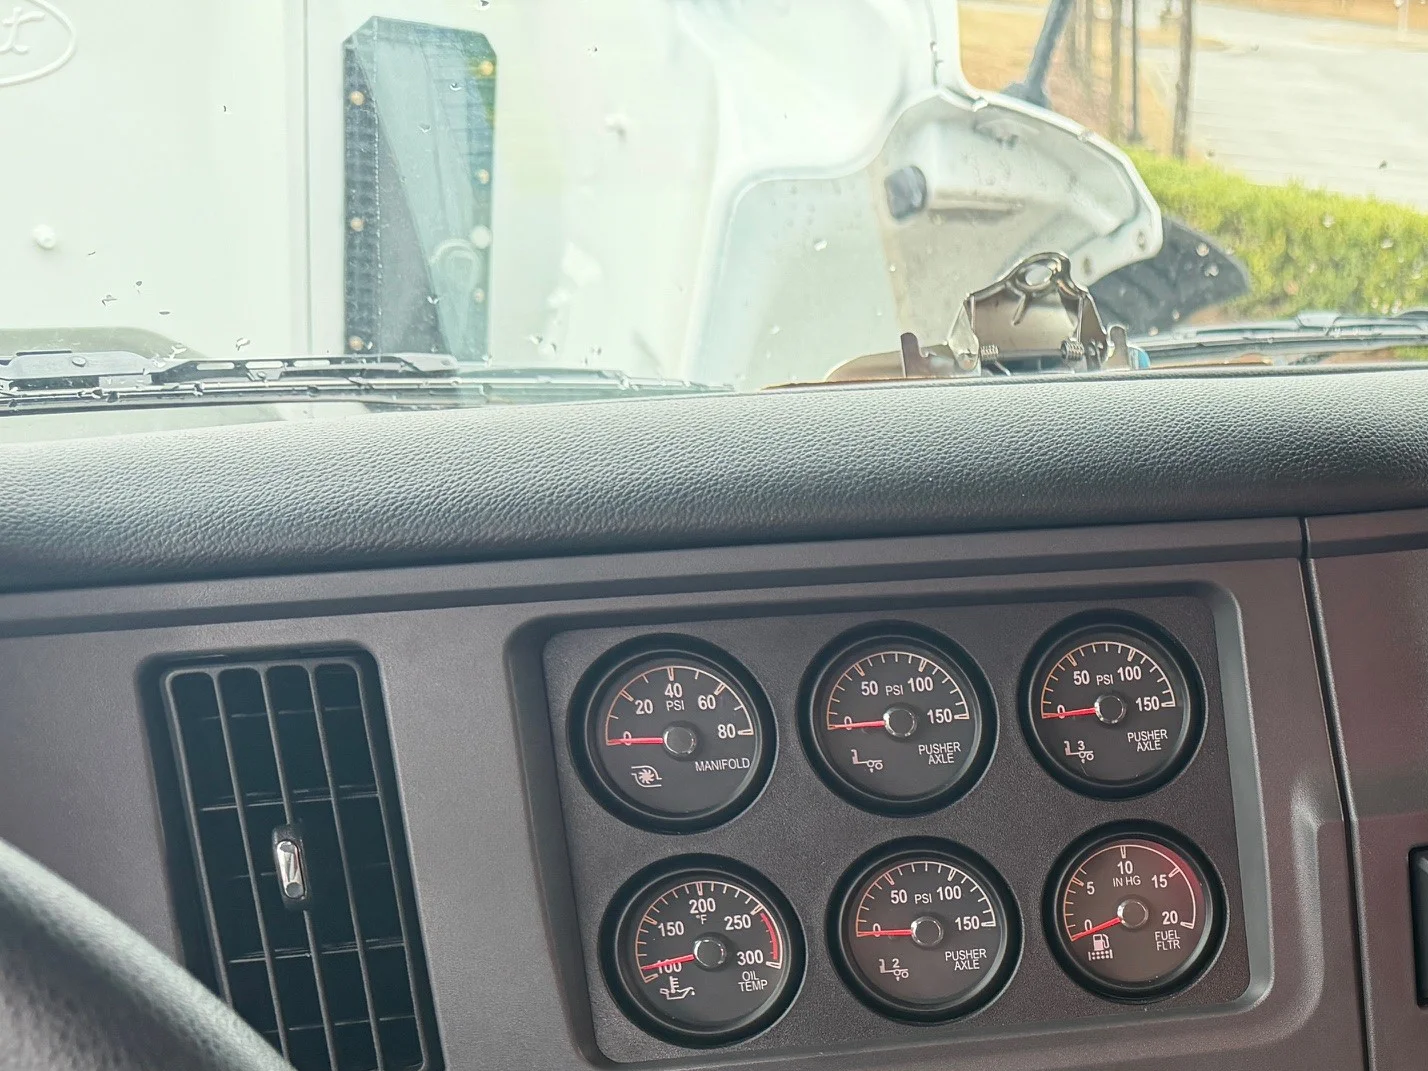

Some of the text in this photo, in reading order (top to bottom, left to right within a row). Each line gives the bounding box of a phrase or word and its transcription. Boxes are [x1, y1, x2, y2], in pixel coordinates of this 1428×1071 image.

[1073, 670, 1090, 685] 50
[1096, 674, 1114, 686] PSI
[1117, 665, 1142, 681] 100
[664, 682, 683, 698] 40
[861, 681, 878, 696] 50
[885, 685, 904, 696] PSI
[908, 676, 933, 692] 100
[635, 699, 654, 715] 20
[666, 700, 685, 712] PSI
[698, 695, 716, 710] 60
[1136, 696, 1160, 712] 150
[927, 708, 953, 724] 150
[717, 723, 736, 739] 80
[1127, 729, 1168, 743] PUSHER
[918, 741, 961, 755] PUSHER
[1077, 740, 1086, 750] 3
[1137, 740, 1162, 752] AXLE
[695, 757, 750, 772] MANIFOLD
[928, 753, 955, 765] AXLE
[1117, 860, 1134, 875] 10
[1086, 881, 1095, 895] 5
[1113, 875, 1141, 887] IN HG
[1151, 874, 1168, 889] 15
[890, 889, 908, 904] 50
[914, 893, 932, 904] PSI
[936, 885, 962, 901] 100
[688, 897, 716, 914] 200
[724, 914, 751, 931] 250
[955, 915, 980, 931] 150
[1161, 910, 1178, 925] 20
[658, 921, 685, 937] 150
[1084, 919, 1093, 932] 0
[1154, 929, 1181, 941] FUEL
[1156, 940, 1181, 951] FLTR
[736, 950, 764, 966] 300
[945, 948, 987, 962] PUSHER
[892, 958, 900, 968] 2
[954, 959, 980, 971] AXLE
[742, 971, 760, 982] OIL
[738, 980, 768, 992] TEMP
